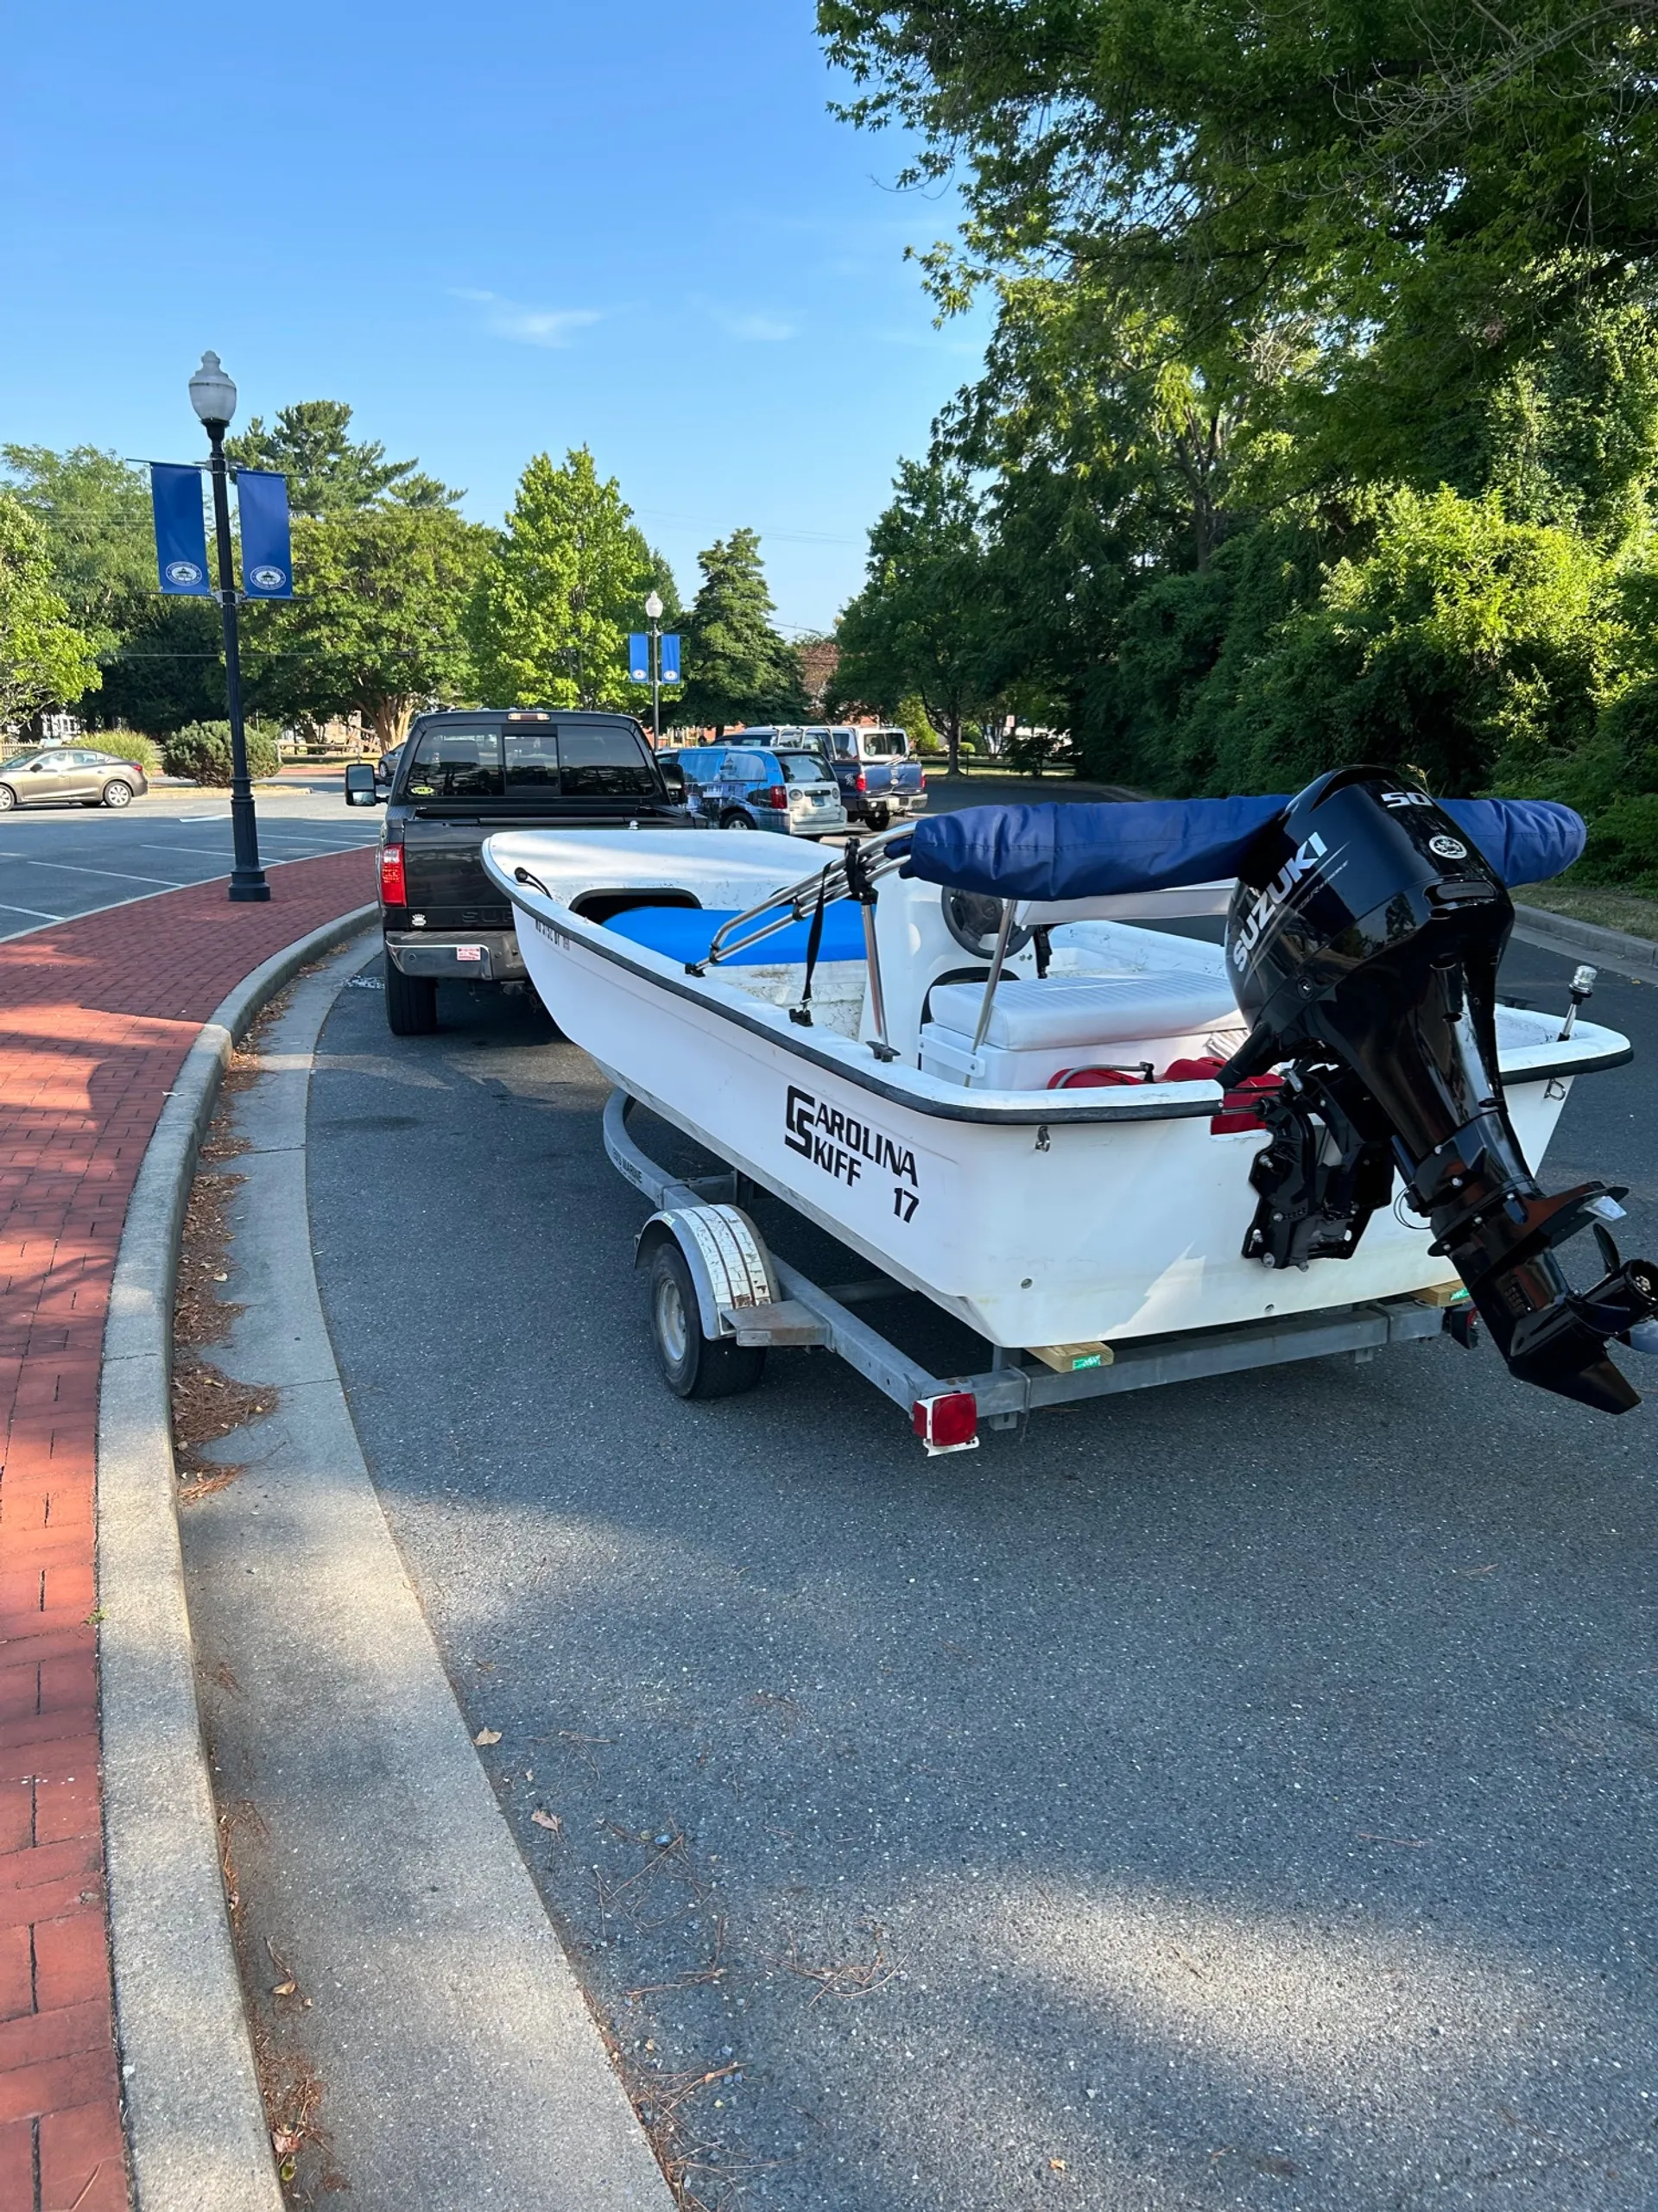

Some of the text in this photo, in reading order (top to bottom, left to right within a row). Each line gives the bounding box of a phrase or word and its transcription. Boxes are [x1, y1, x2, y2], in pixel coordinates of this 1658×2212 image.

[1381, 792, 1433, 808] 50
[1233, 831, 1328, 972] SUZUKI
[784, 1108, 862, 1187] SKIFF
[786, 1084, 919, 1188] CAROLINA
[894, 1187, 920, 1224] 17
